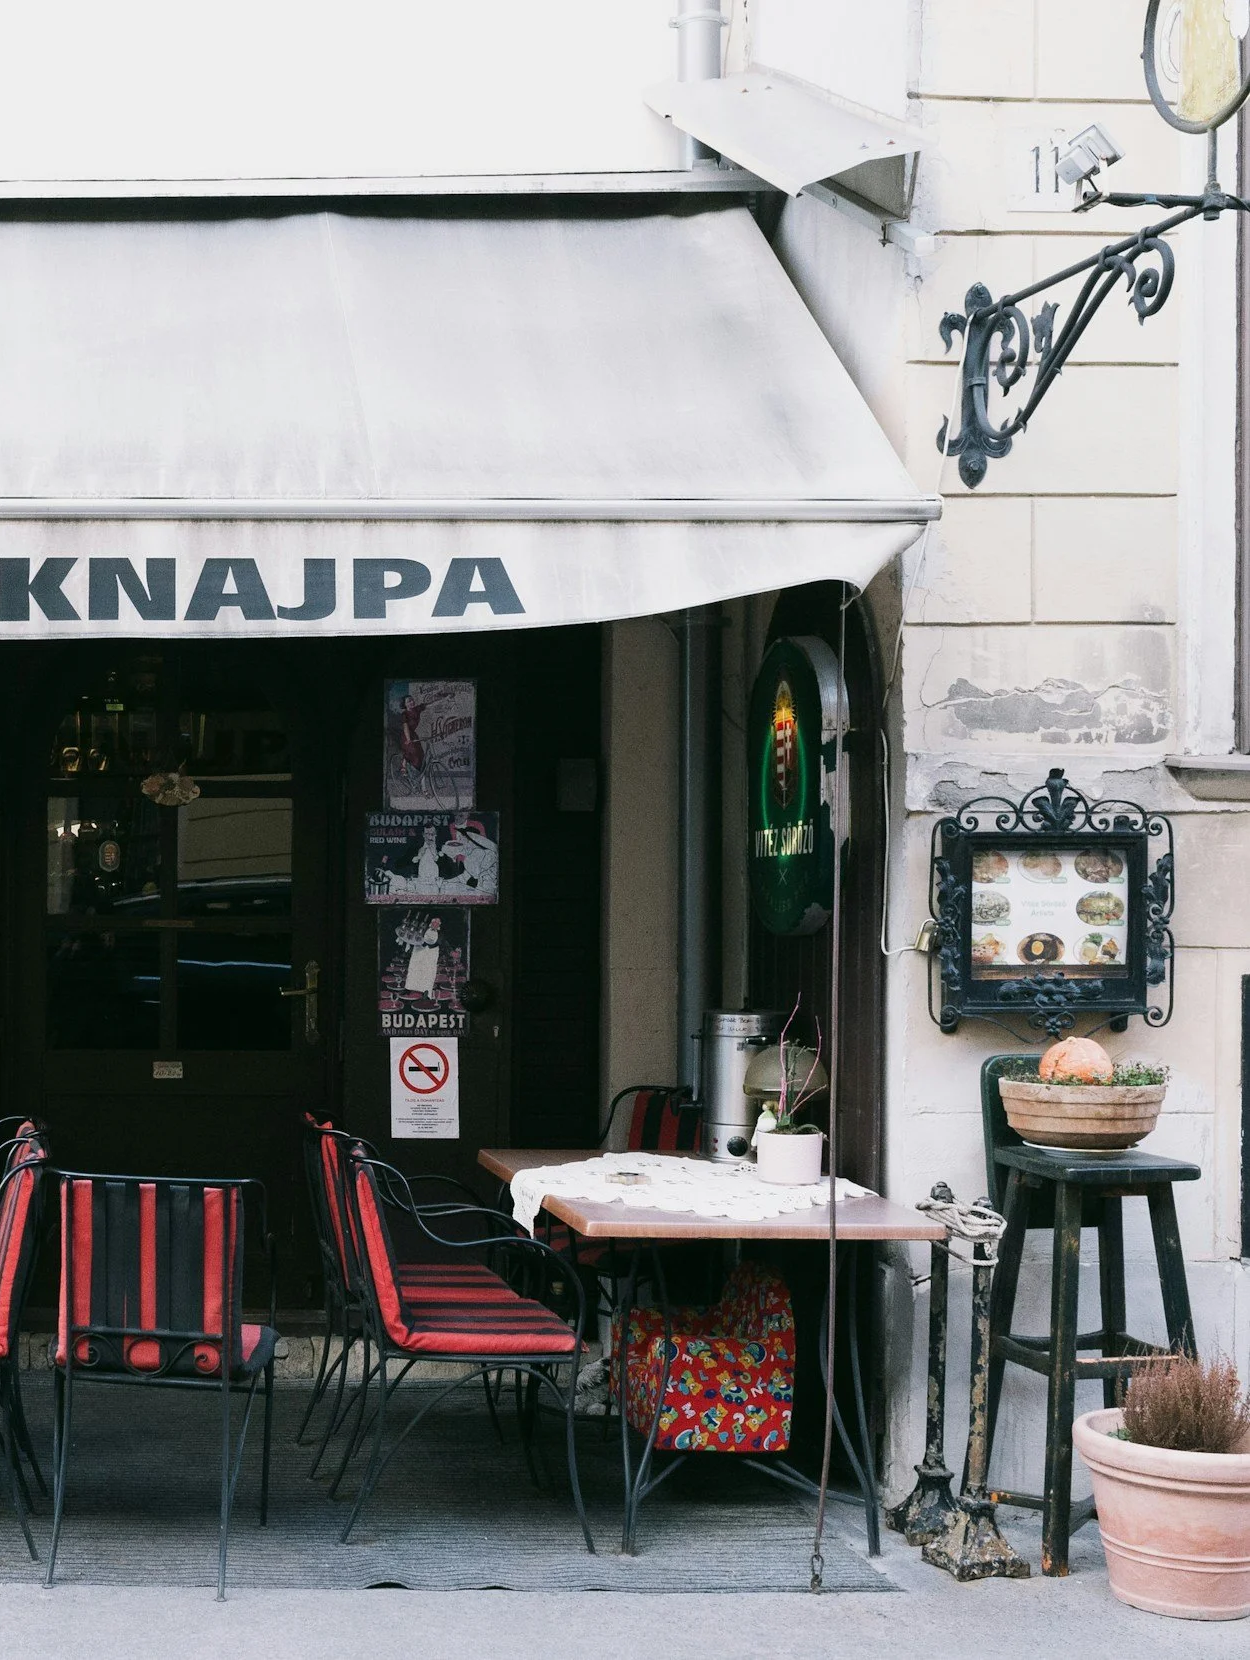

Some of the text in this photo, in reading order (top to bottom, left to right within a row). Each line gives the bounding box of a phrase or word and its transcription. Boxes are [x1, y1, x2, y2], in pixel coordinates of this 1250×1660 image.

[1030, 146, 1060, 194] 11
[369, 814, 451, 827] BUDAPEST
[755, 823, 779, 858] VITÉZ
[381, 1013, 465, 1029] BUDAPEST
